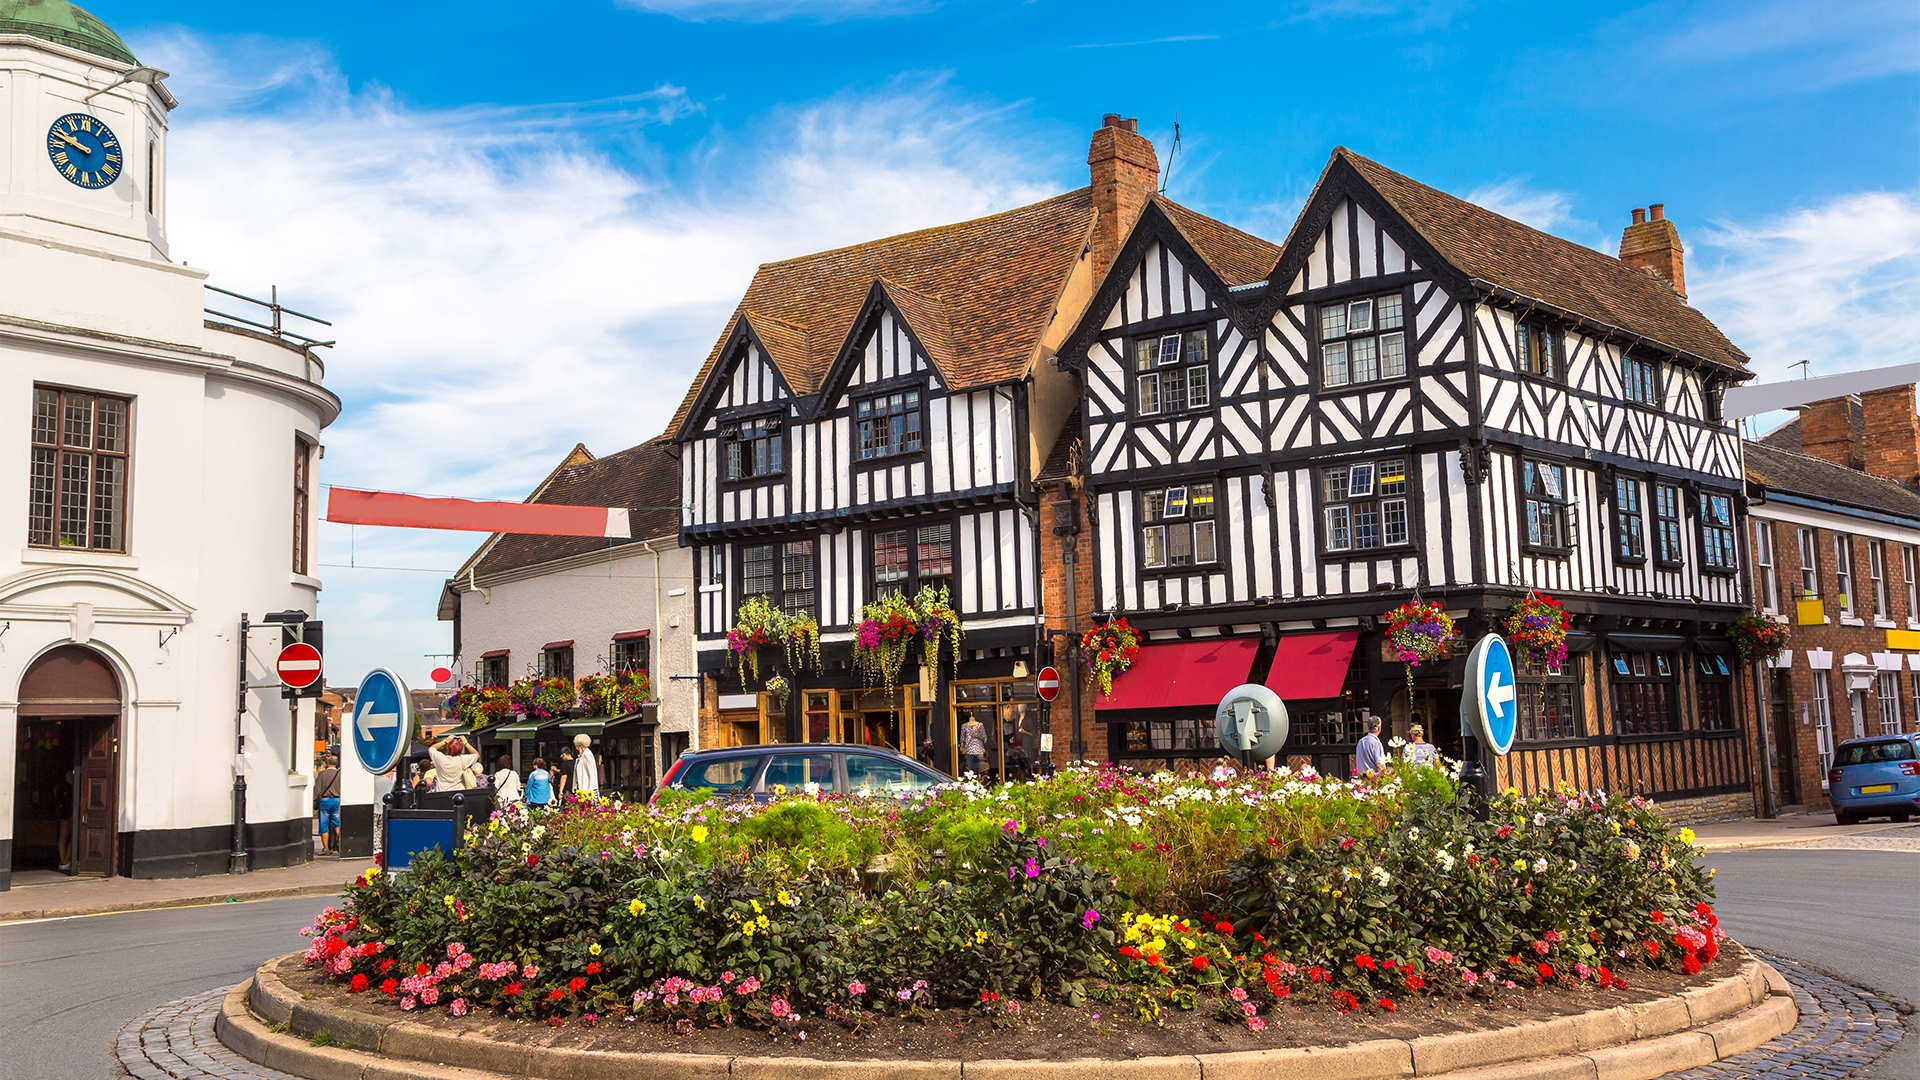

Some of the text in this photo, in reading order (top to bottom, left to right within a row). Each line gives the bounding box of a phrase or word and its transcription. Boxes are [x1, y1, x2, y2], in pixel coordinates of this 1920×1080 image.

[66, 119, 78, 132] XI
[81, 120, 90, 132] XII
[57, 127, 68, 136] X
[96, 126, 104, 136] I
[53, 140, 65, 149] IX
[106, 154, 117, 162] III
[82, 171, 90, 184] VI
[94, 171, 104, 182] V
